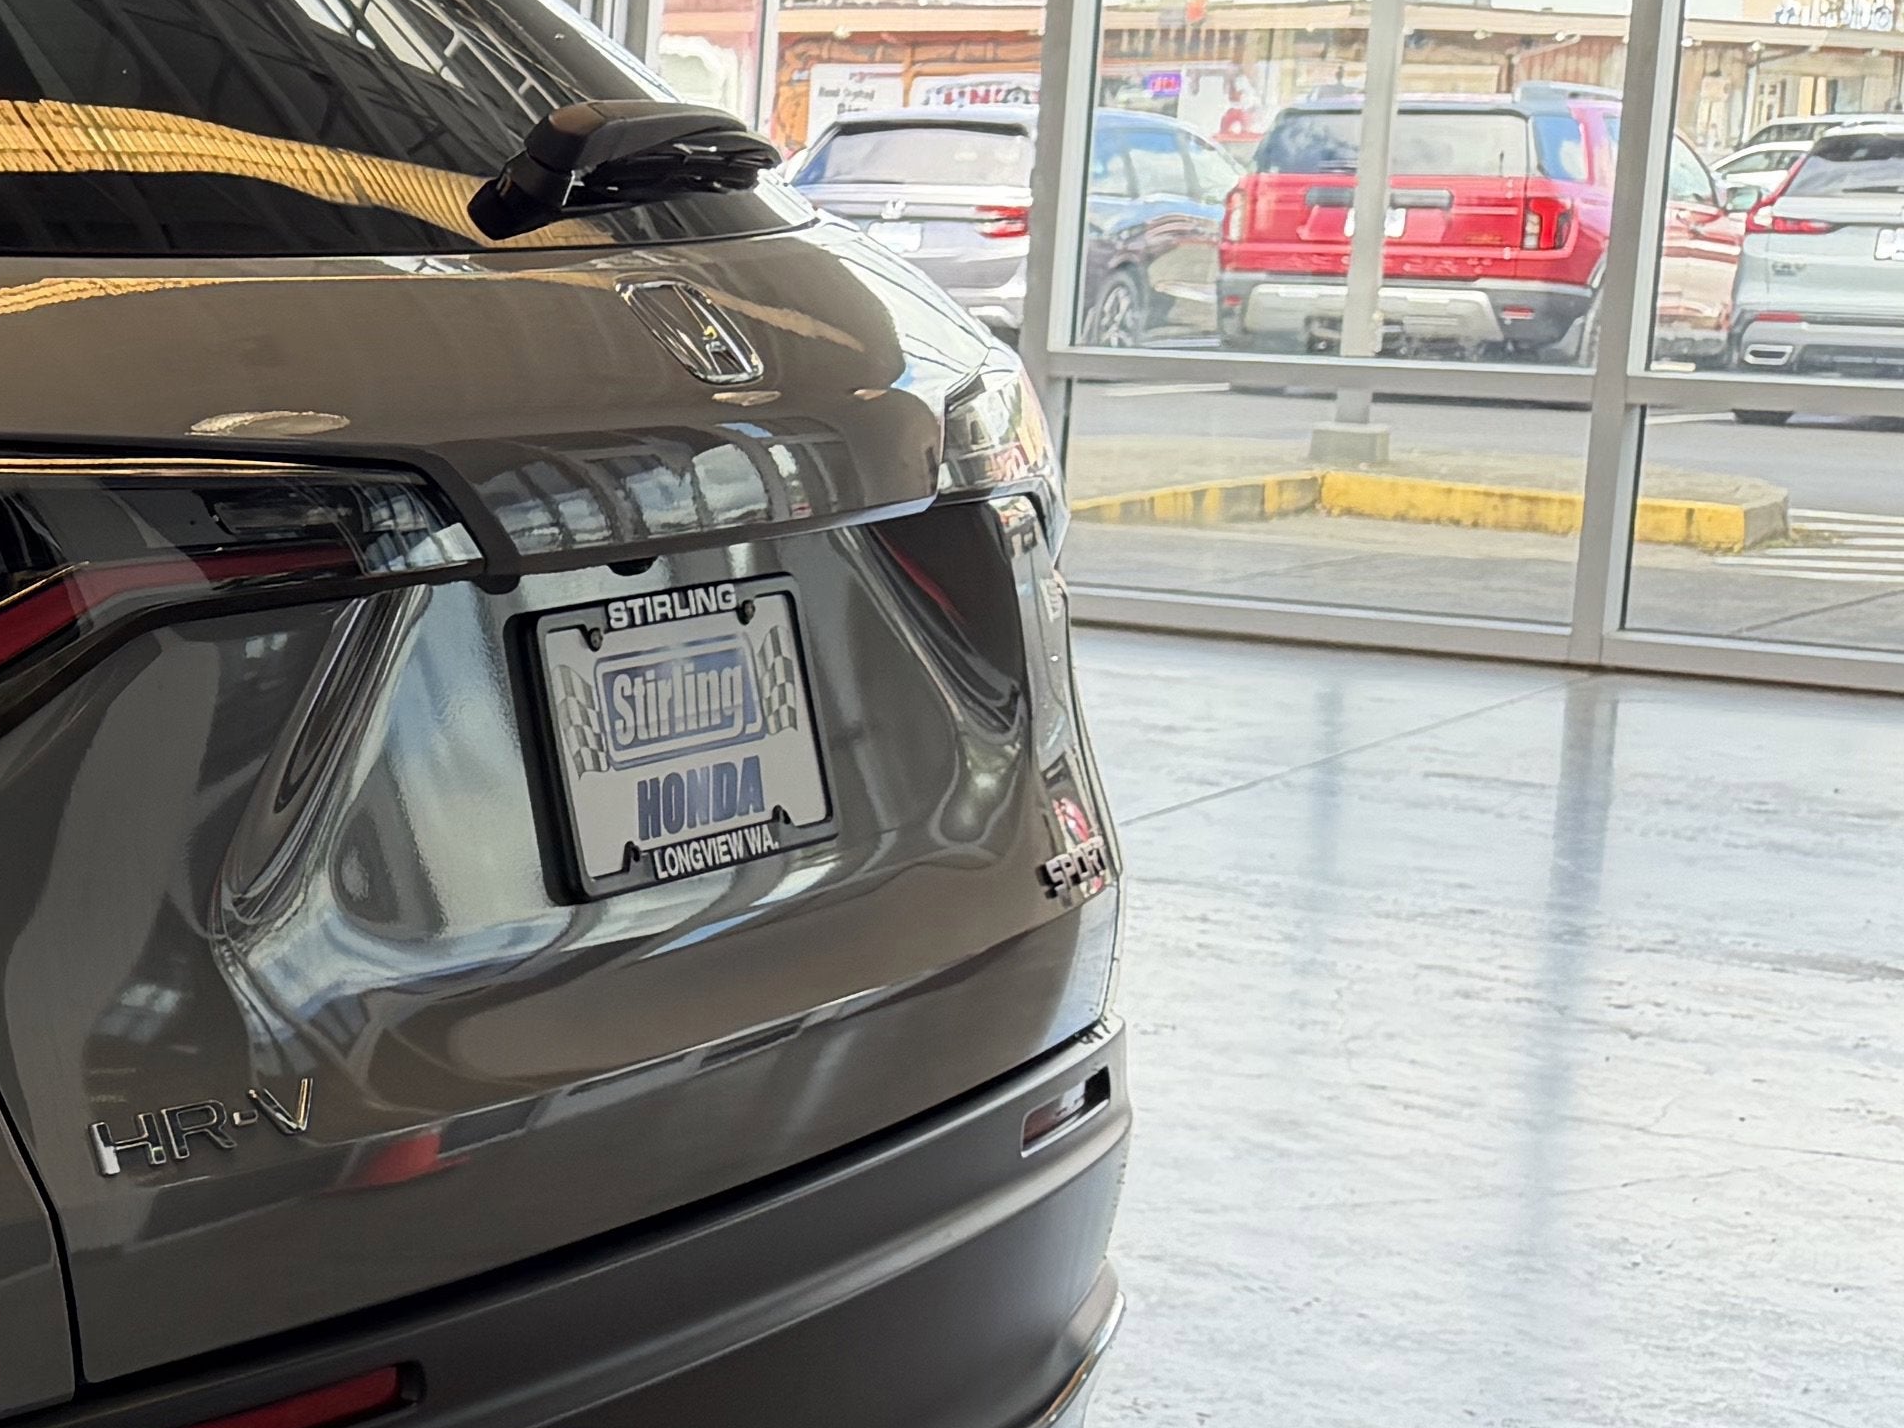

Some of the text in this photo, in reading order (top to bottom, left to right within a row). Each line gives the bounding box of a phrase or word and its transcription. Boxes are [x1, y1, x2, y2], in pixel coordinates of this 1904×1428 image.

[607, 583, 738, 628] STIRLING
[612, 662, 743, 746] Stirling
[637, 755, 765, 841] HONDA
[653, 823, 780, 879] LONGVIEW WA.
[1045, 835, 1112, 890] SPORT
[90, 1077, 314, 1175] HR-V
